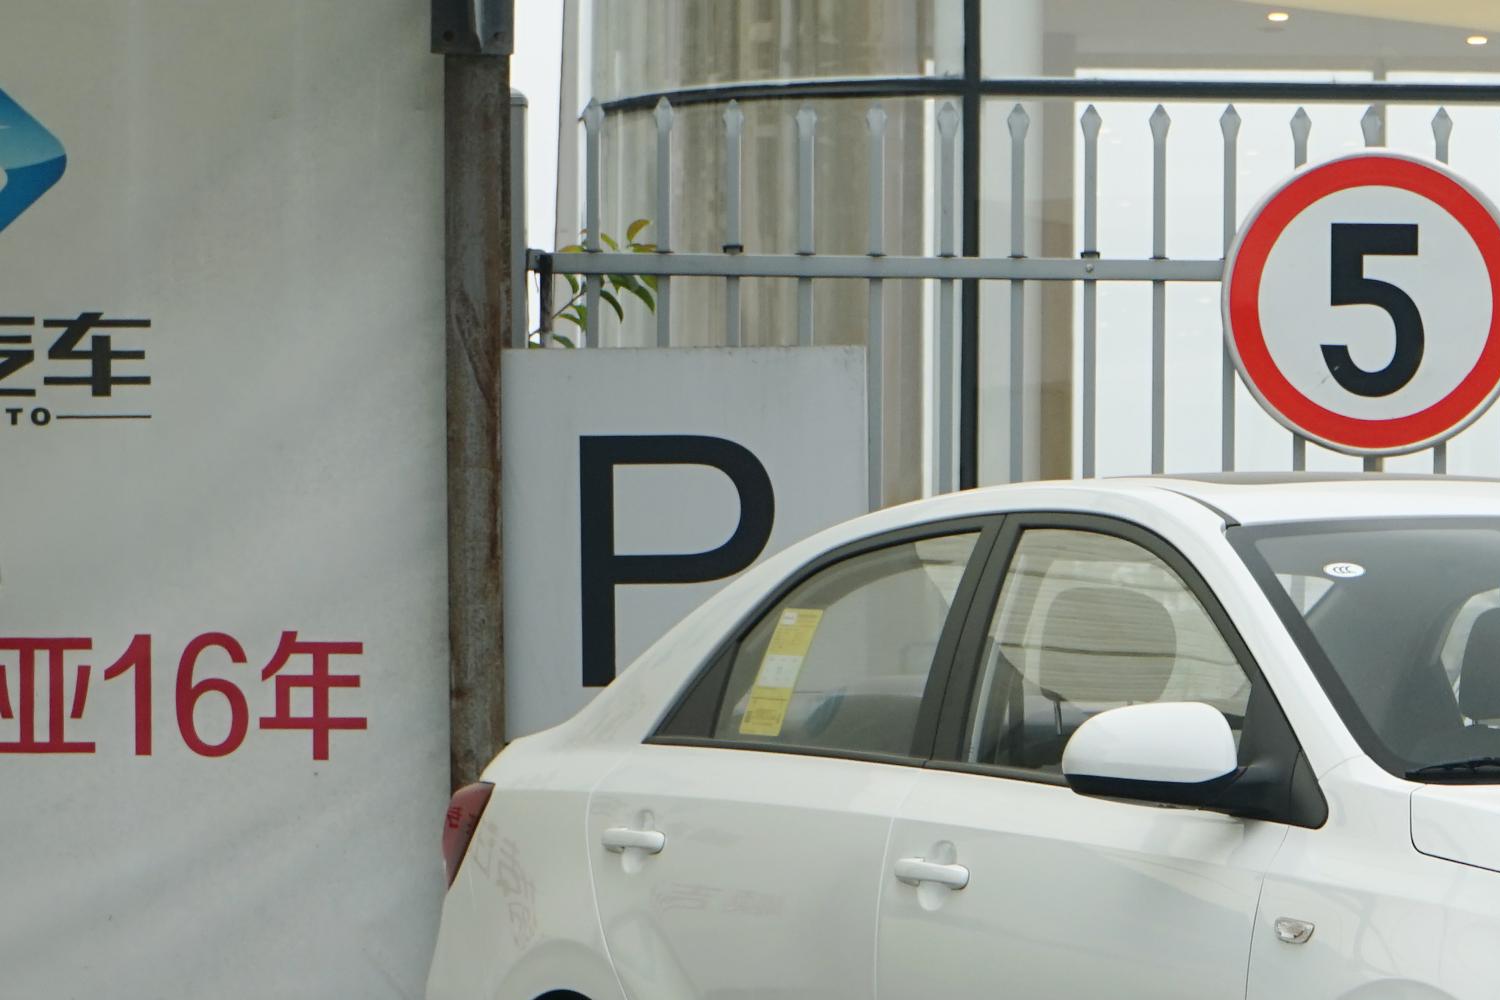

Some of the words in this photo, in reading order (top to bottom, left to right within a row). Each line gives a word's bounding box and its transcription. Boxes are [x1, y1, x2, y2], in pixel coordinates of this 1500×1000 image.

[1320, 223, 1425, 398] 5
[579, 435, 775, 688] P
[0, 630, 368, 761] 亚16年
